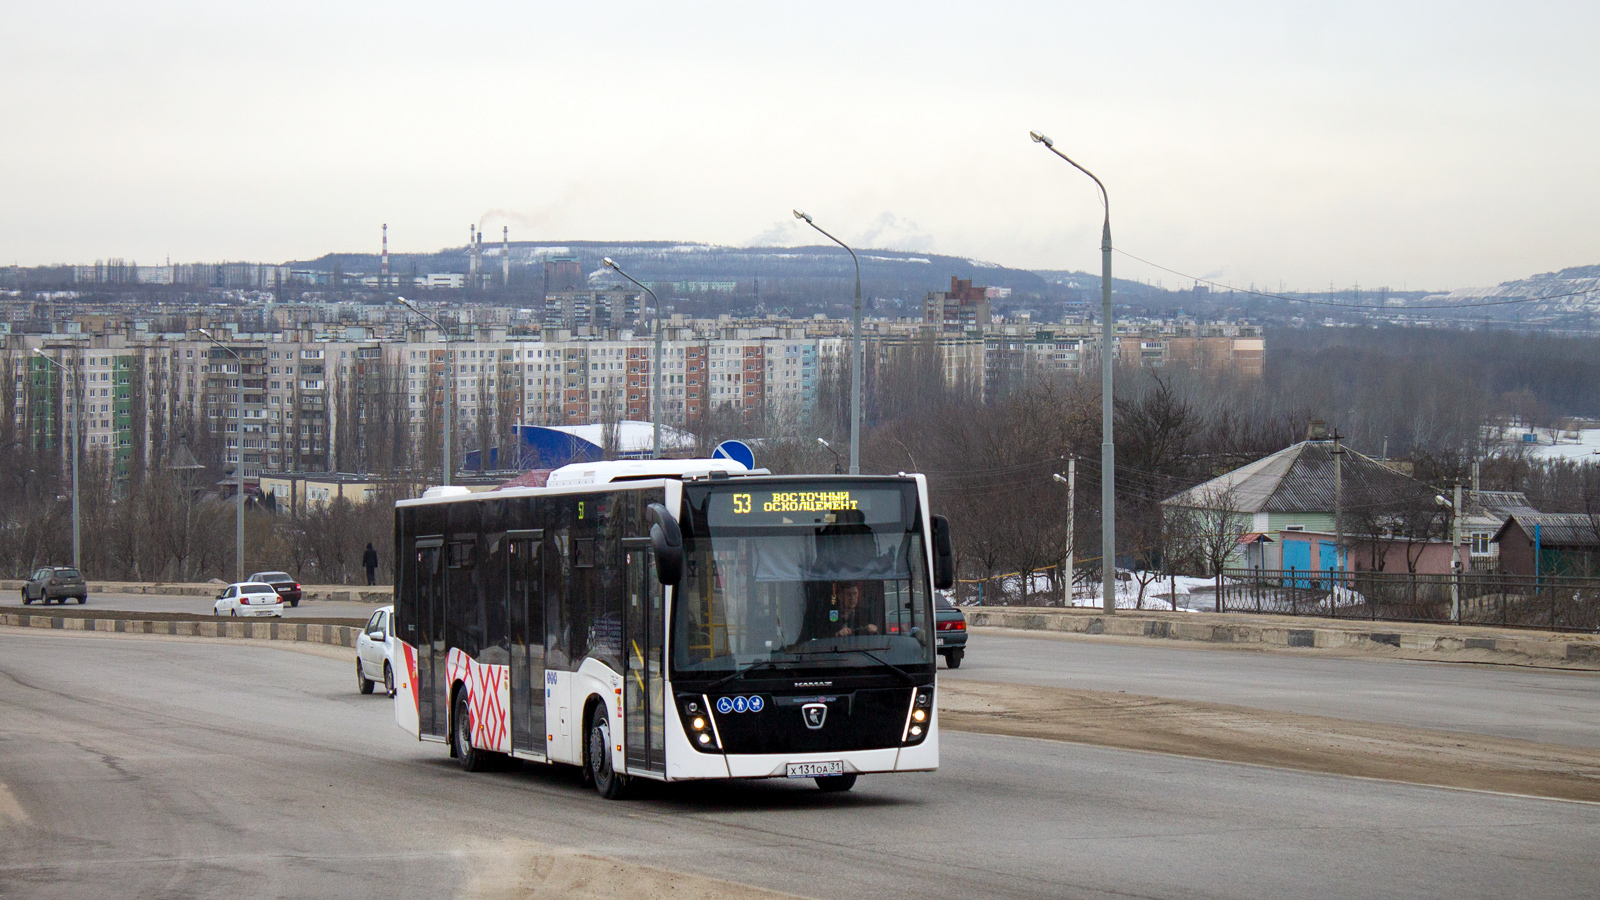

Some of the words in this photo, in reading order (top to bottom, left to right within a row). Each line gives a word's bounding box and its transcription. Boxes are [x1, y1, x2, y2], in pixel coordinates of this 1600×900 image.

[772, 491, 850, 502] ВОСТОЧНЫЙ
[733, 493, 752, 514] 53
[764, 500, 858, 512] ОСКОЛЦЕМЕНТ
[830, 762, 840, 770] 31
